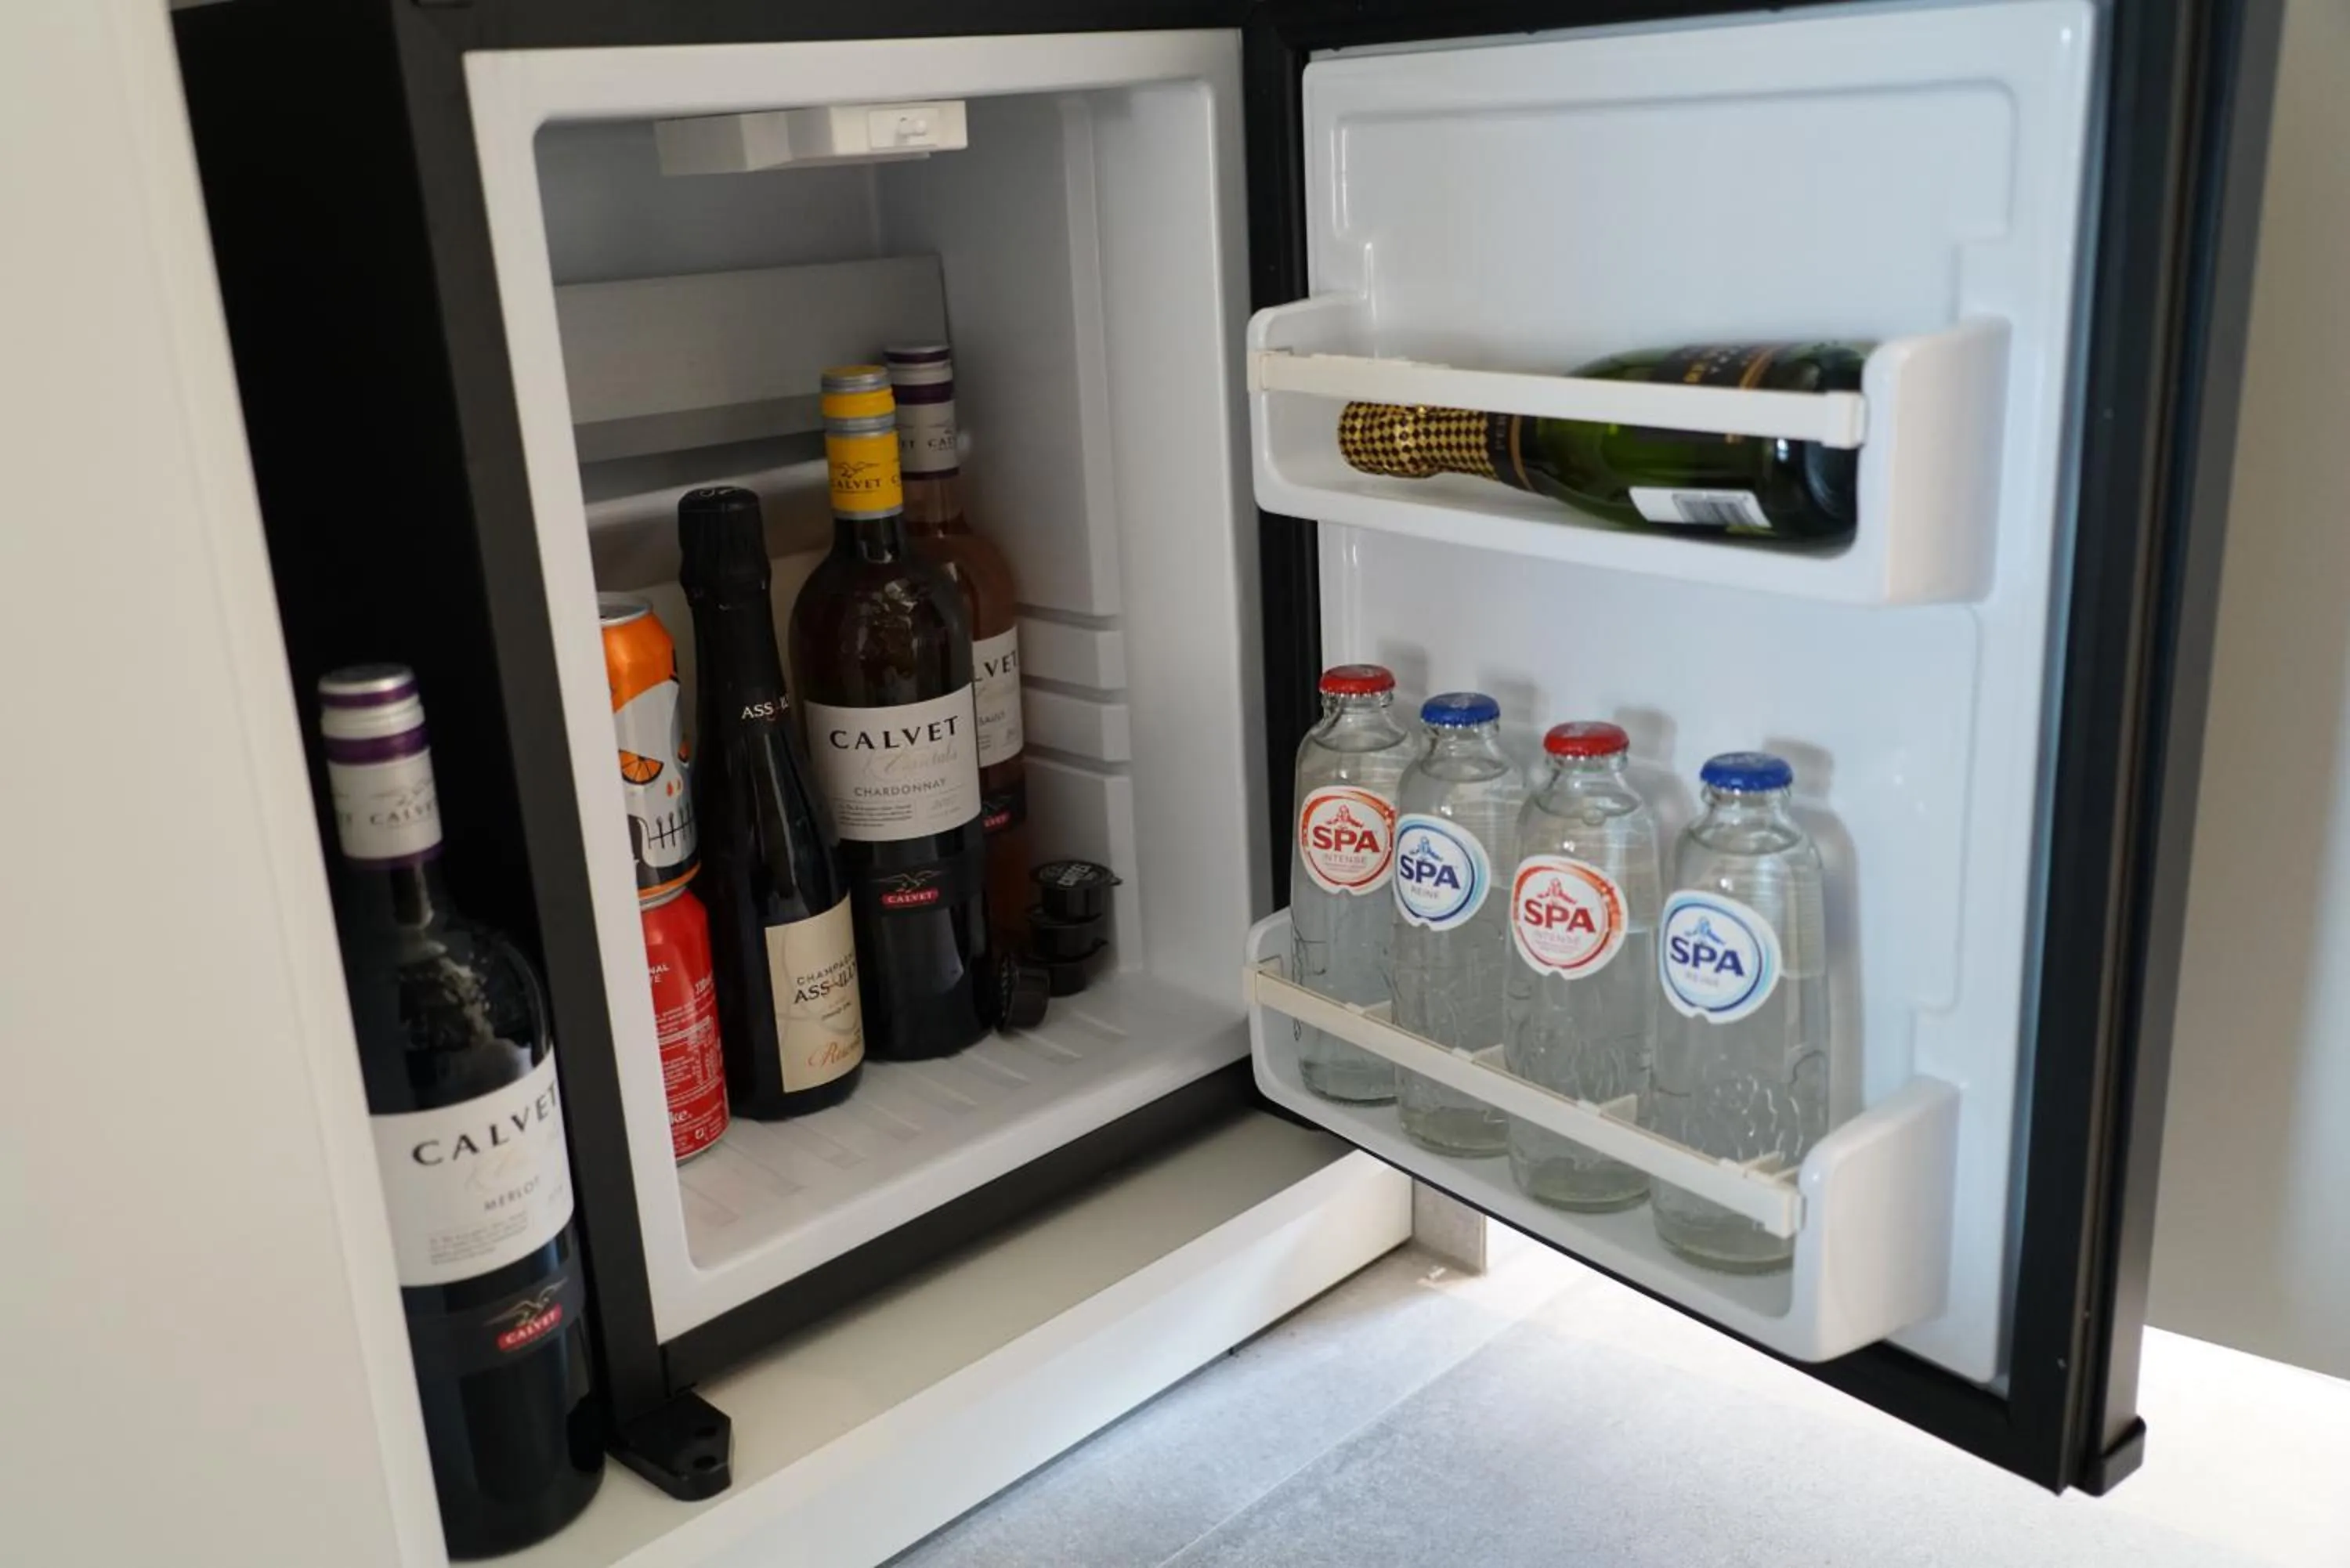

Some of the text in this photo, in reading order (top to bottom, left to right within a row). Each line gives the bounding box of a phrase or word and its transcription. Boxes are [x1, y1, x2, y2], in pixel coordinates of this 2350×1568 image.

[830, 716, 958, 750] CALVET
[854, 778, 946, 798] CHARDONNAY
[1312, 825, 1380, 854] SPA
[1400, 854, 1461, 890] SPA
[887, 891, 935, 904] CALVET
[1524, 898, 1596, 934] SPA
[1670, 936, 1745, 977] SPA
[412, 1081, 559, 1166] CALVET
[483, 1175, 540, 1211] MERLOT
[505, 1310, 555, 1345] CALVET
